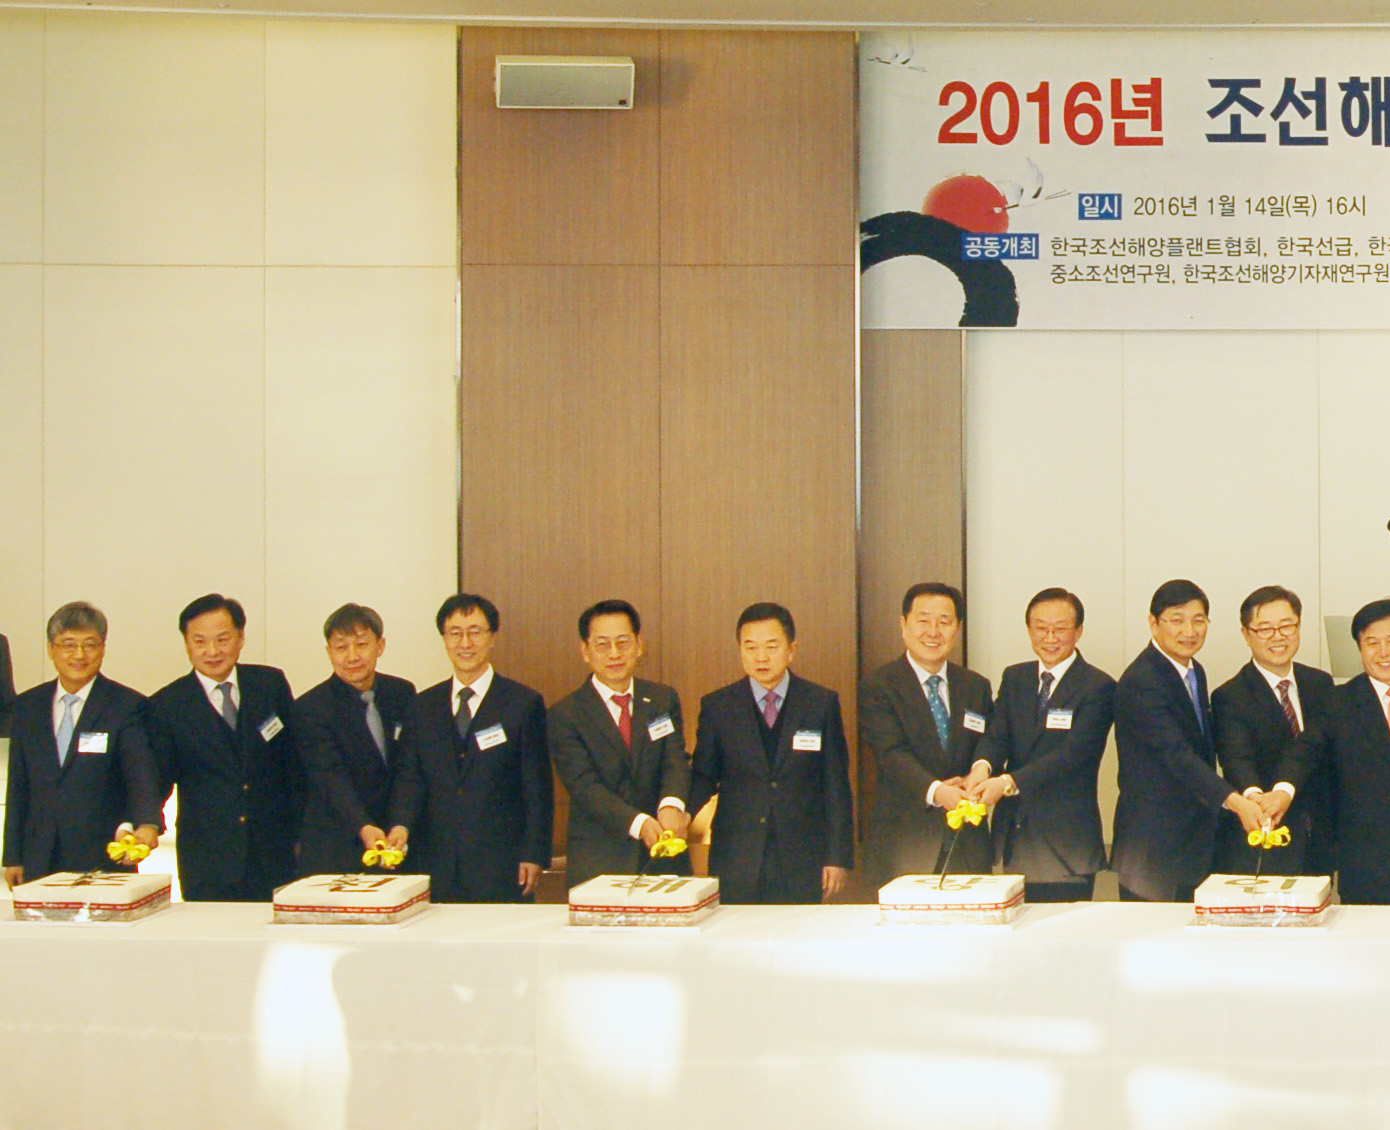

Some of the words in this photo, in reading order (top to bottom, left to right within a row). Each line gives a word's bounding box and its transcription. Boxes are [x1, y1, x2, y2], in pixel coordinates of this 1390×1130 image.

[937, 76, 1164, 147] 2016년
[1080, 196, 1121, 218] 일시
[1133, 195, 1198, 217] 2016년
[1207, 194, 1236, 217] 1월
[1245, 193, 1318, 218] 14일(목)
[1326, 194, 1366, 217] 16시
[964, 236, 1038, 258] 공동개최
[1050, 236, 1268, 258] 한국조선해양플랜트협회,
[1276, 236, 1359, 257] 한국선급,
[1050, 263, 1176, 285] 중소조선연구원,
